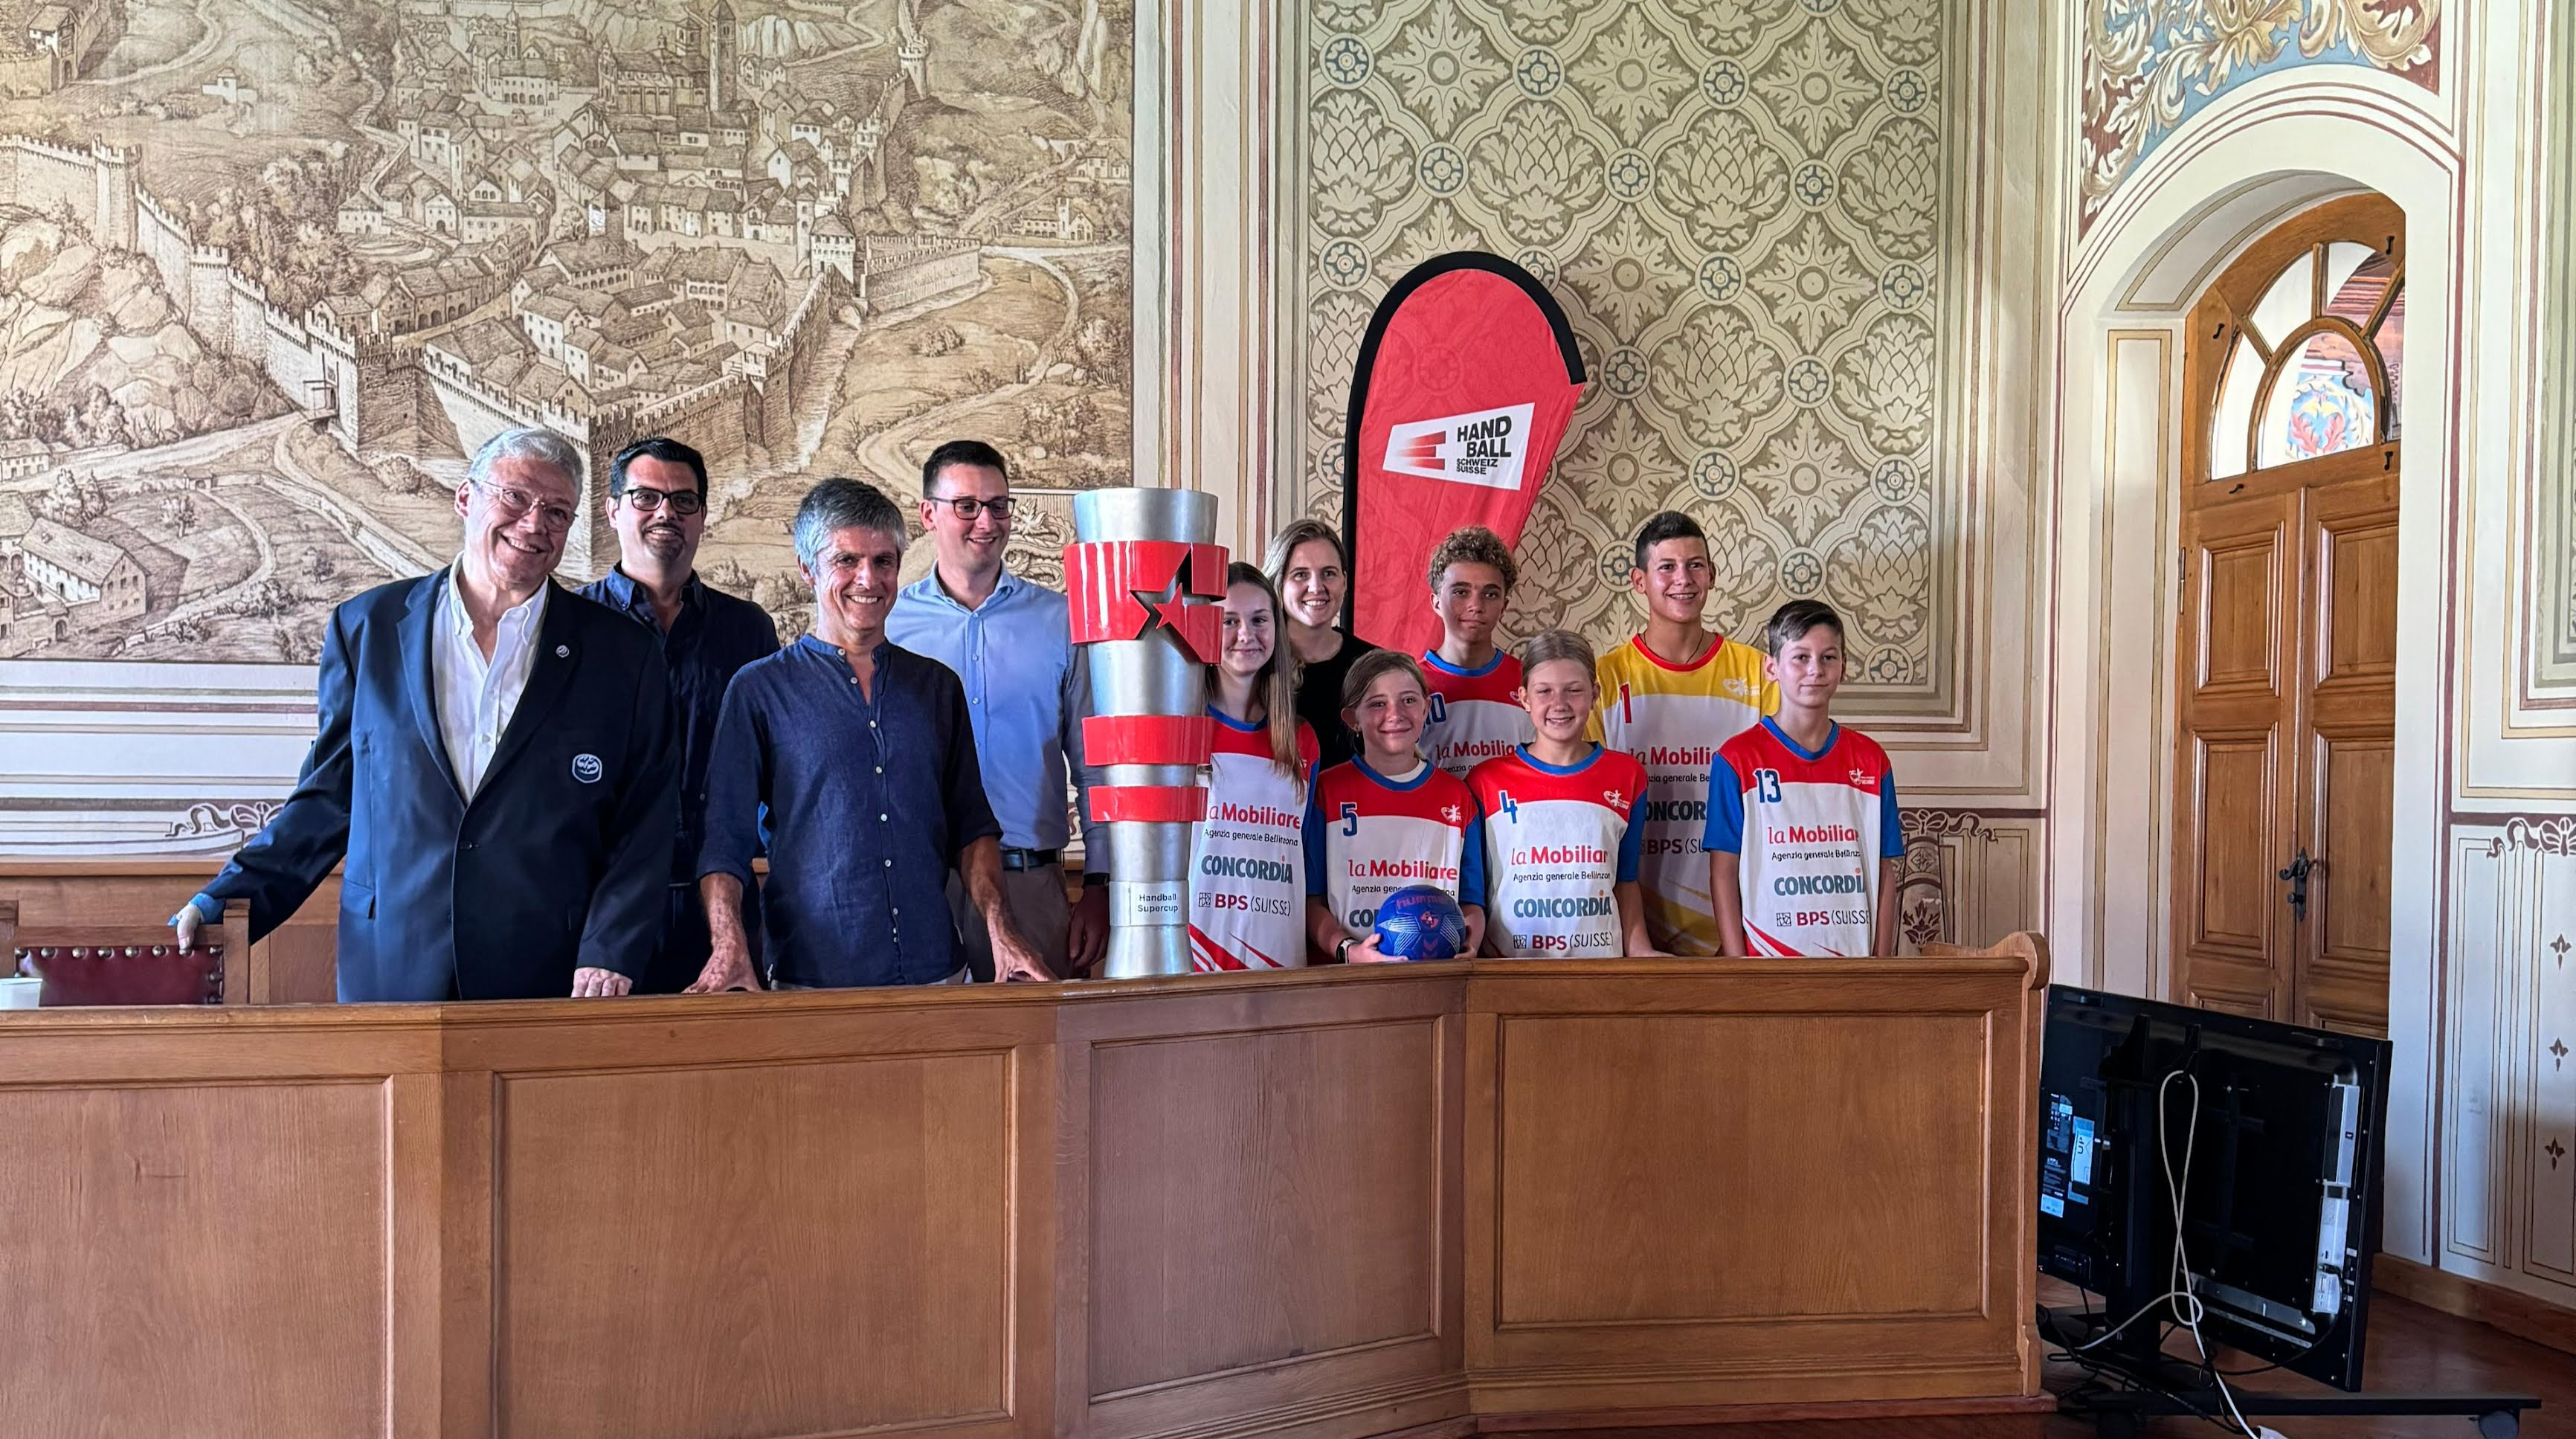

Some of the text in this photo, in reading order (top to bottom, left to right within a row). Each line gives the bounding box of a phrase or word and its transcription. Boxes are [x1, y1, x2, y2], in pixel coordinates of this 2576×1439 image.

[1457, 416, 1512, 442] HAND
[1466, 437, 1512, 457] BALL
[1456, 458, 1498, 467] SCHWEIZ
[1456, 466, 1487, 474] SUISSE
[1619, 682, 1632, 724] 1
[1436, 740, 1515, 759] la Mobilia
[1651, 747, 1710, 765] Mobili
[1663, 773, 1697, 784] generale
[1753, 768, 1782, 803] 13
[1209, 802, 1301, 829] a Mobiliare
[1499, 790, 1518, 824] 4
[1645, 800, 1707, 821] ONCOR
[1341, 802, 1358, 836] 5
[1204, 828, 1230, 838] Agenzia
[1232, 831, 1263, 841] generale
[1768, 826, 1786, 844] la
[1647, 839, 1683, 854] BPS
[1511, 846, 1608, 866] la Mobiliar
[1771, 852, 1802, 861] Agenzia
[1348, 860, 1458, 881] la Mobiliare
[1513, 872, 1543, 883] Agenzia
[1546, 871, 1579, 882] generale
[1139, 893, 1176, 901] Handball
[1352, 885, 1381, 895] Agenzia
[1138, 904, 1178, 913] Supercup
[1214, 893, 1291, 917] BPS (SUISSE)
[1796, 911, 1830, 926] BPS
[1532, 931, 1613, 950] BPS (SUISSE)
